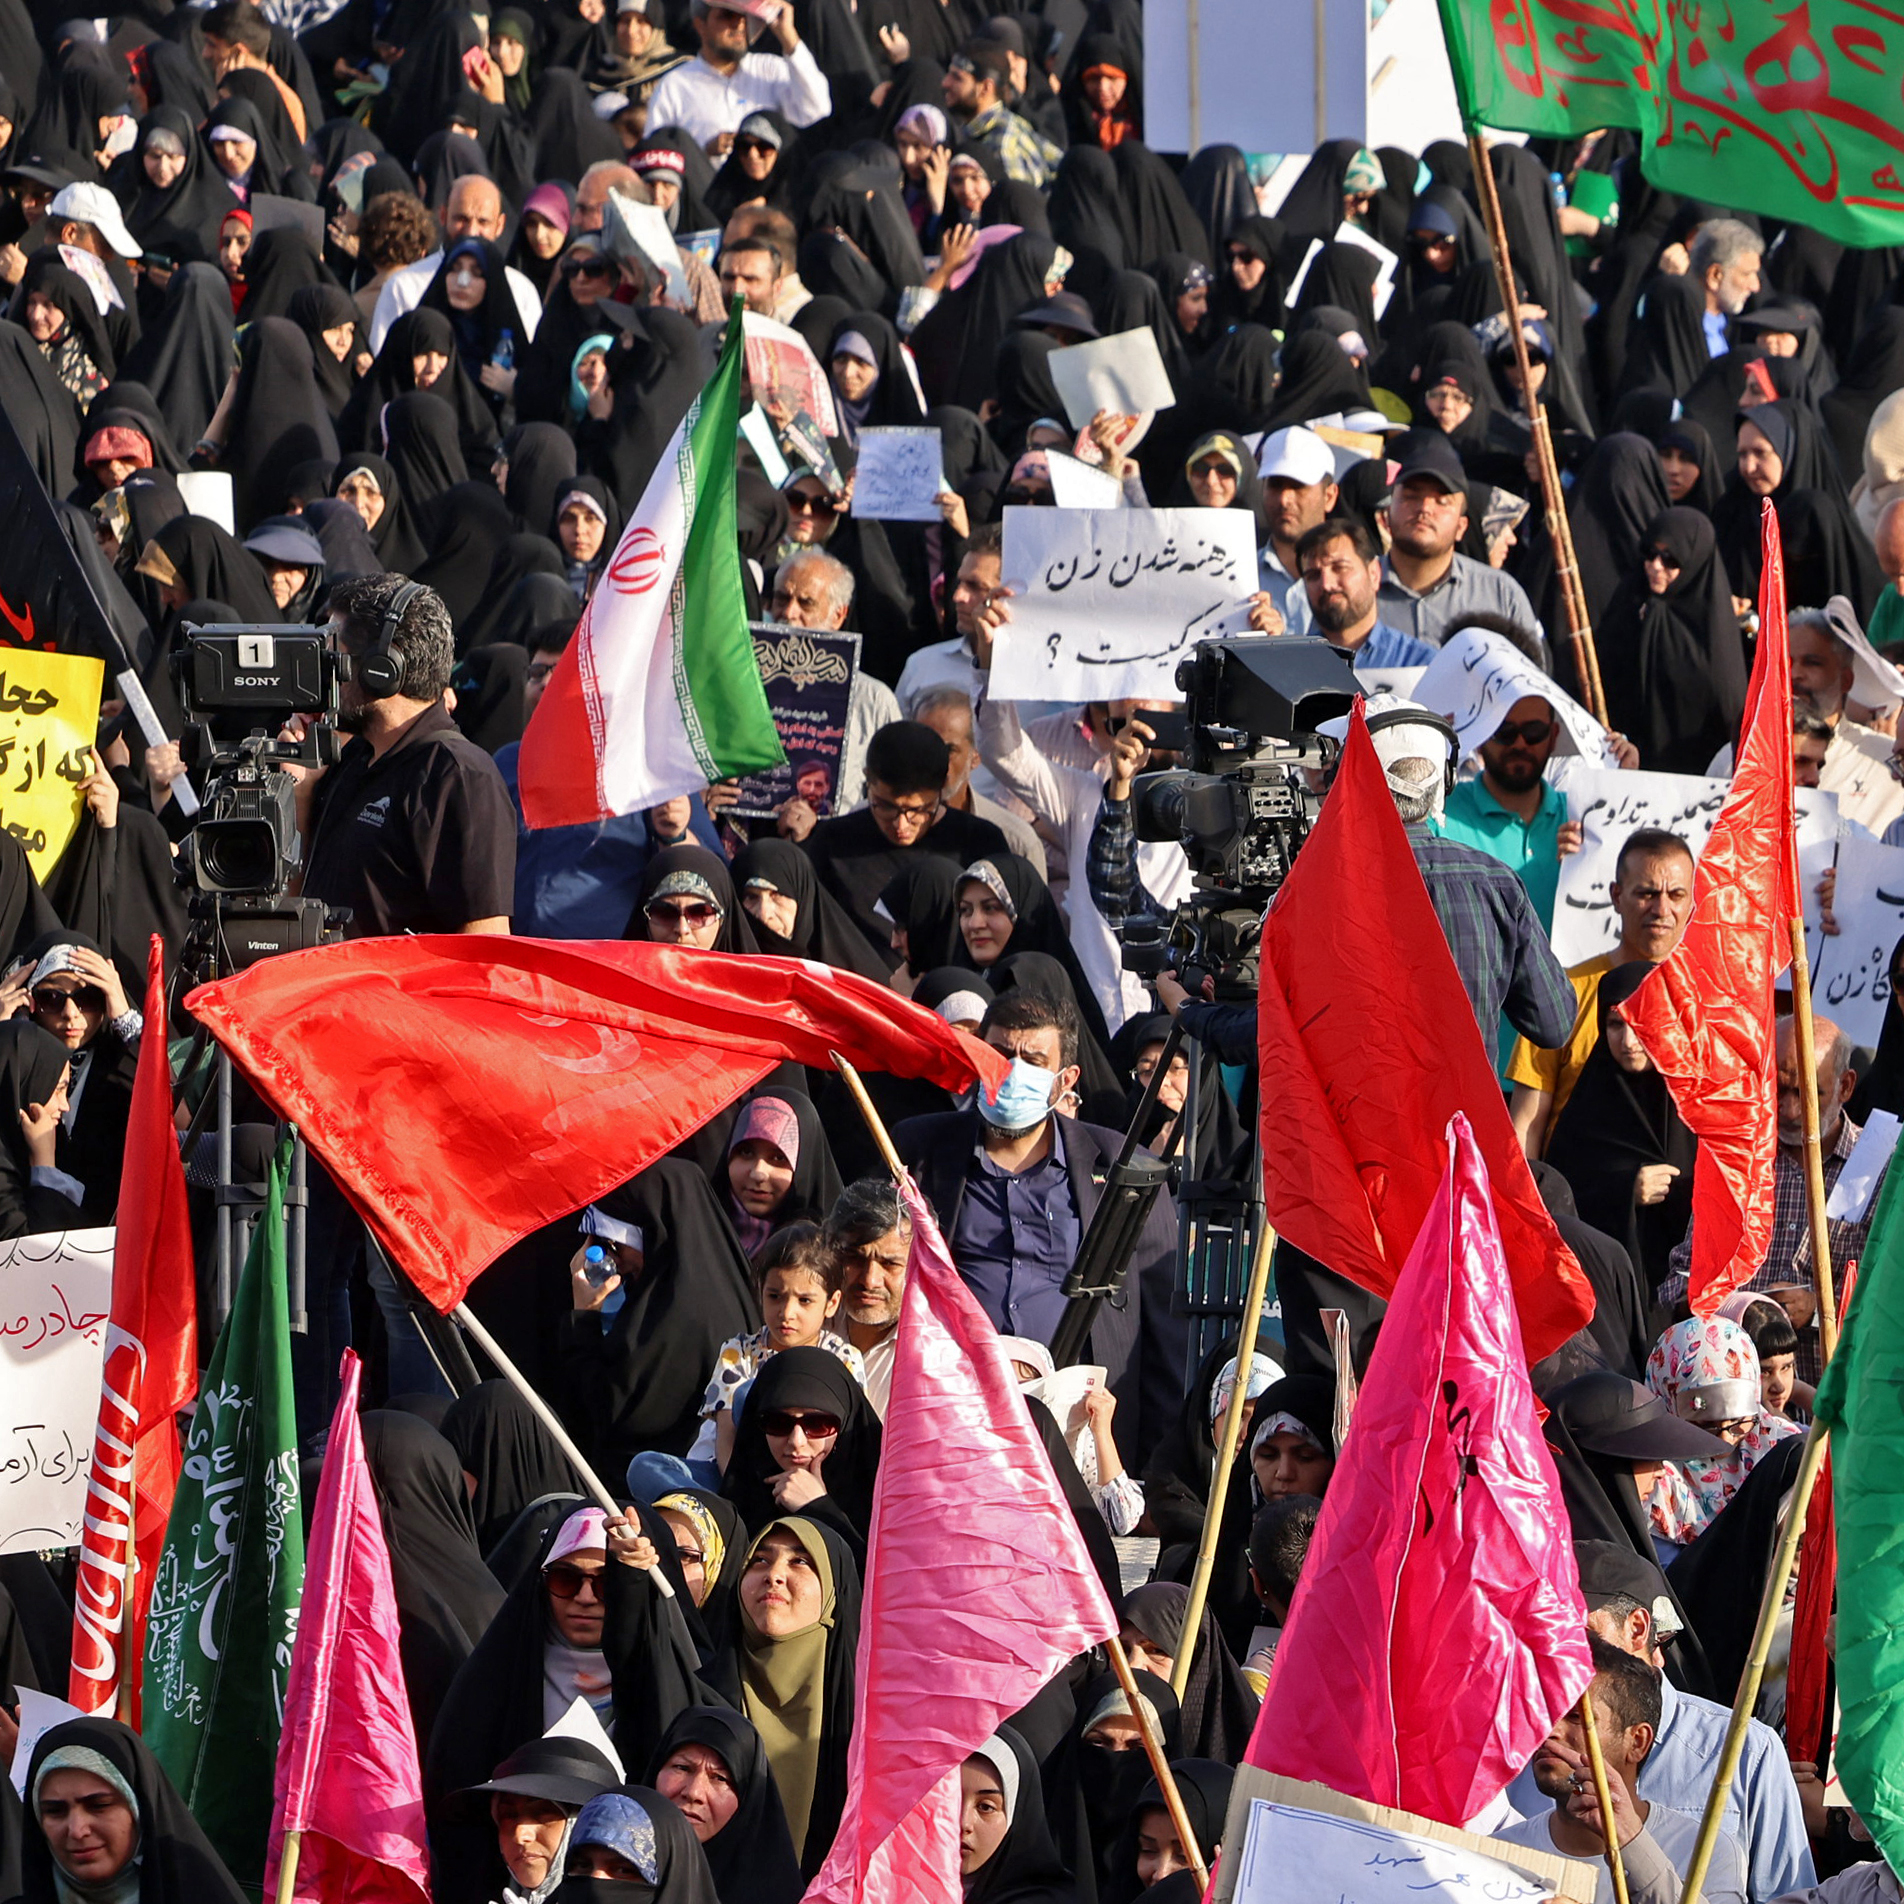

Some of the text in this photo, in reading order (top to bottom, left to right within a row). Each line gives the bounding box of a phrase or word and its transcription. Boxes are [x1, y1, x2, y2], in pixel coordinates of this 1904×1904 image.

[1046, 549, 1102, 591] زن
[248, 642, 260, 663] 1
[234, 676, 281, 686] SONY
[247, 940, 279, 951] Vinten
[22, 1283, 110, 1350] چادر
